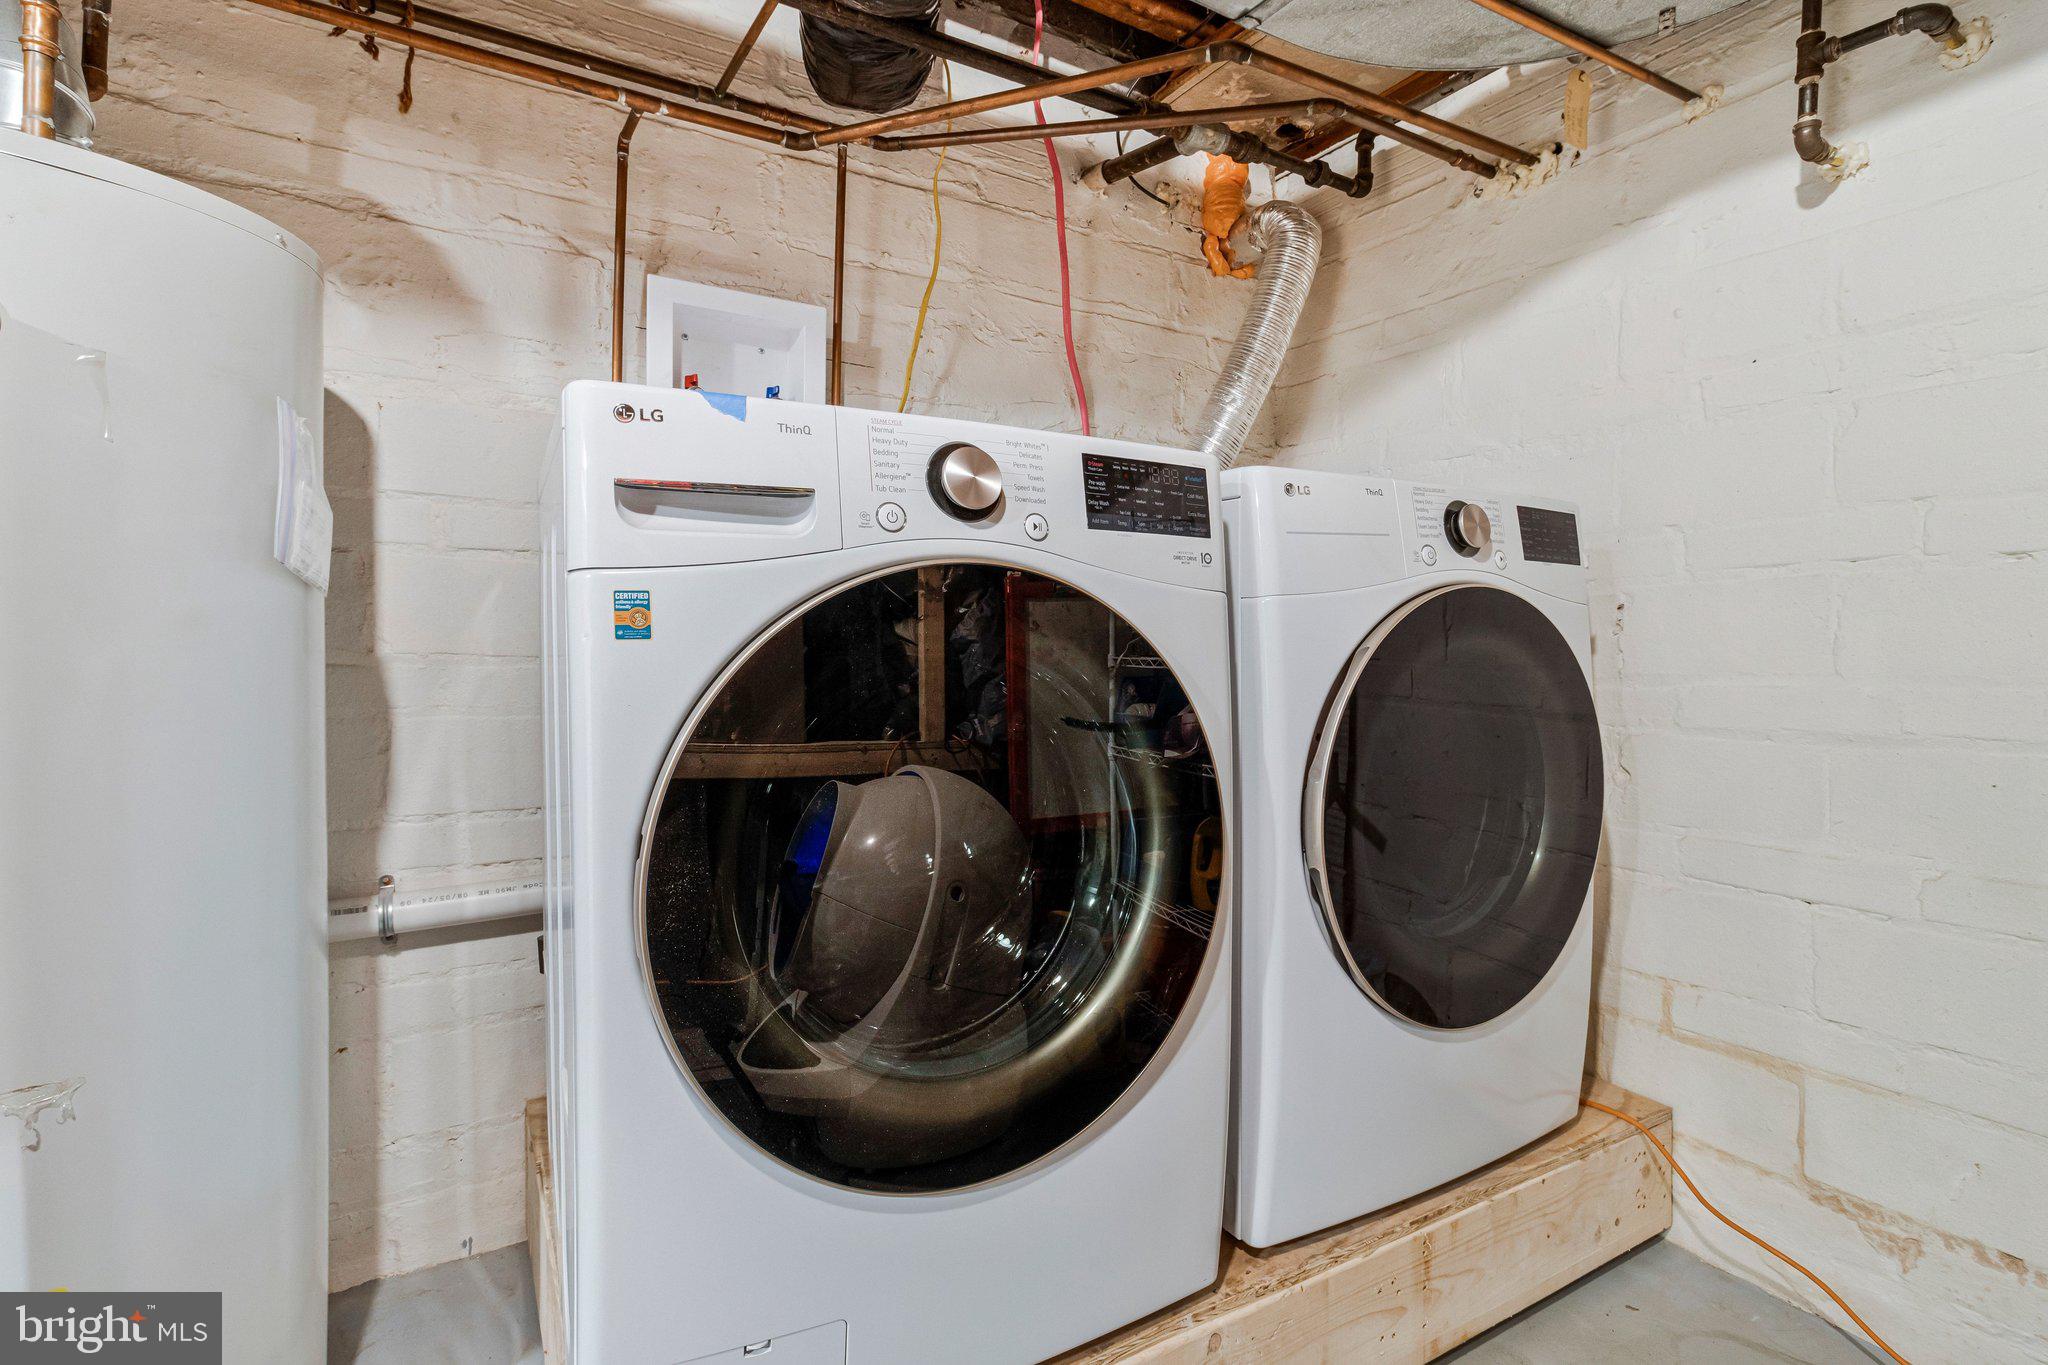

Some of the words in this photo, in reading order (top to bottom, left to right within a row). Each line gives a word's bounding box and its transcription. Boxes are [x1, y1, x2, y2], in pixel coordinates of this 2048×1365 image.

[639, 408, 664, 422] LG
[777, 422, 813, 436] ThinQ
[871, 425, 895, 434] Normal
[872, 437, 891, 446] Heavy
[893, 438, 909, 448] Duty
[1005, 440, 1022, 449] Bright
[872, 448, 899, 459] Bedding
[1018, 451, 1043, 461] Delicates
[873, 460, 900, 470] Sanitary
[1027, 473, 1045, 482] Towels
[875, 484, 887, 492] Tub
[888, 485, 907, 493] Clean
[1013, 483, 1031, 492] Speed
[1297, 485, 1311, 496] LG
[1365, 488, 1384, 497] ThinQ
[1014, 495, 1047, 505] Downloaded
[615, 592, 649, 600] CERTIFIED
